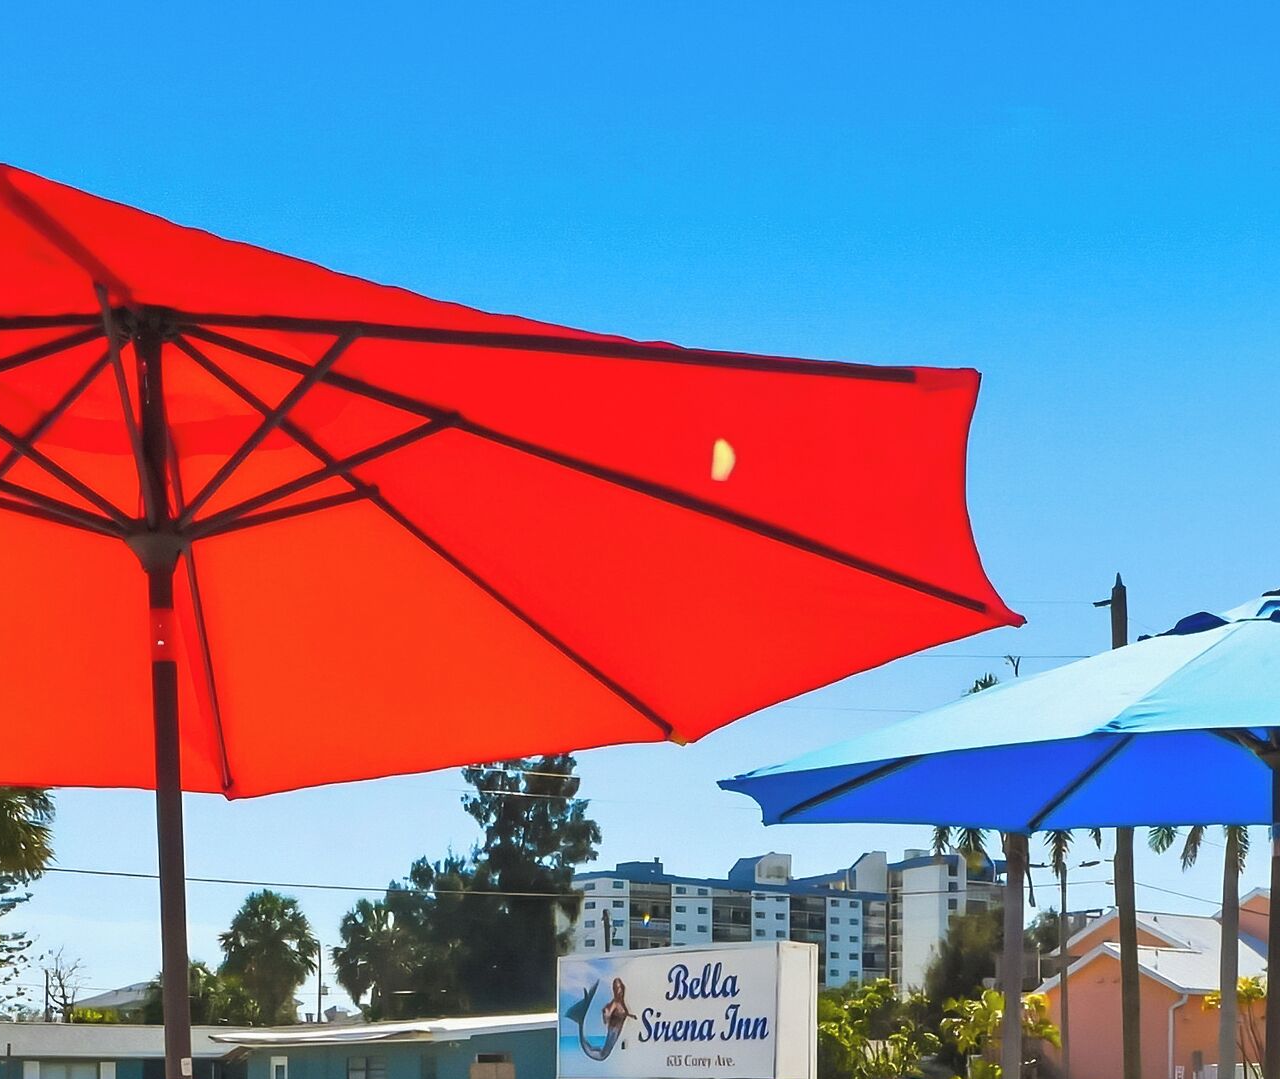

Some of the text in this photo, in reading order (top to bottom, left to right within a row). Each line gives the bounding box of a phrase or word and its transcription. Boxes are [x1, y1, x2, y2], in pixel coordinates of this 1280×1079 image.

[665, 962, 740, 1001] Bella
[638, 1004, 769, 1042] Sirena Inn
